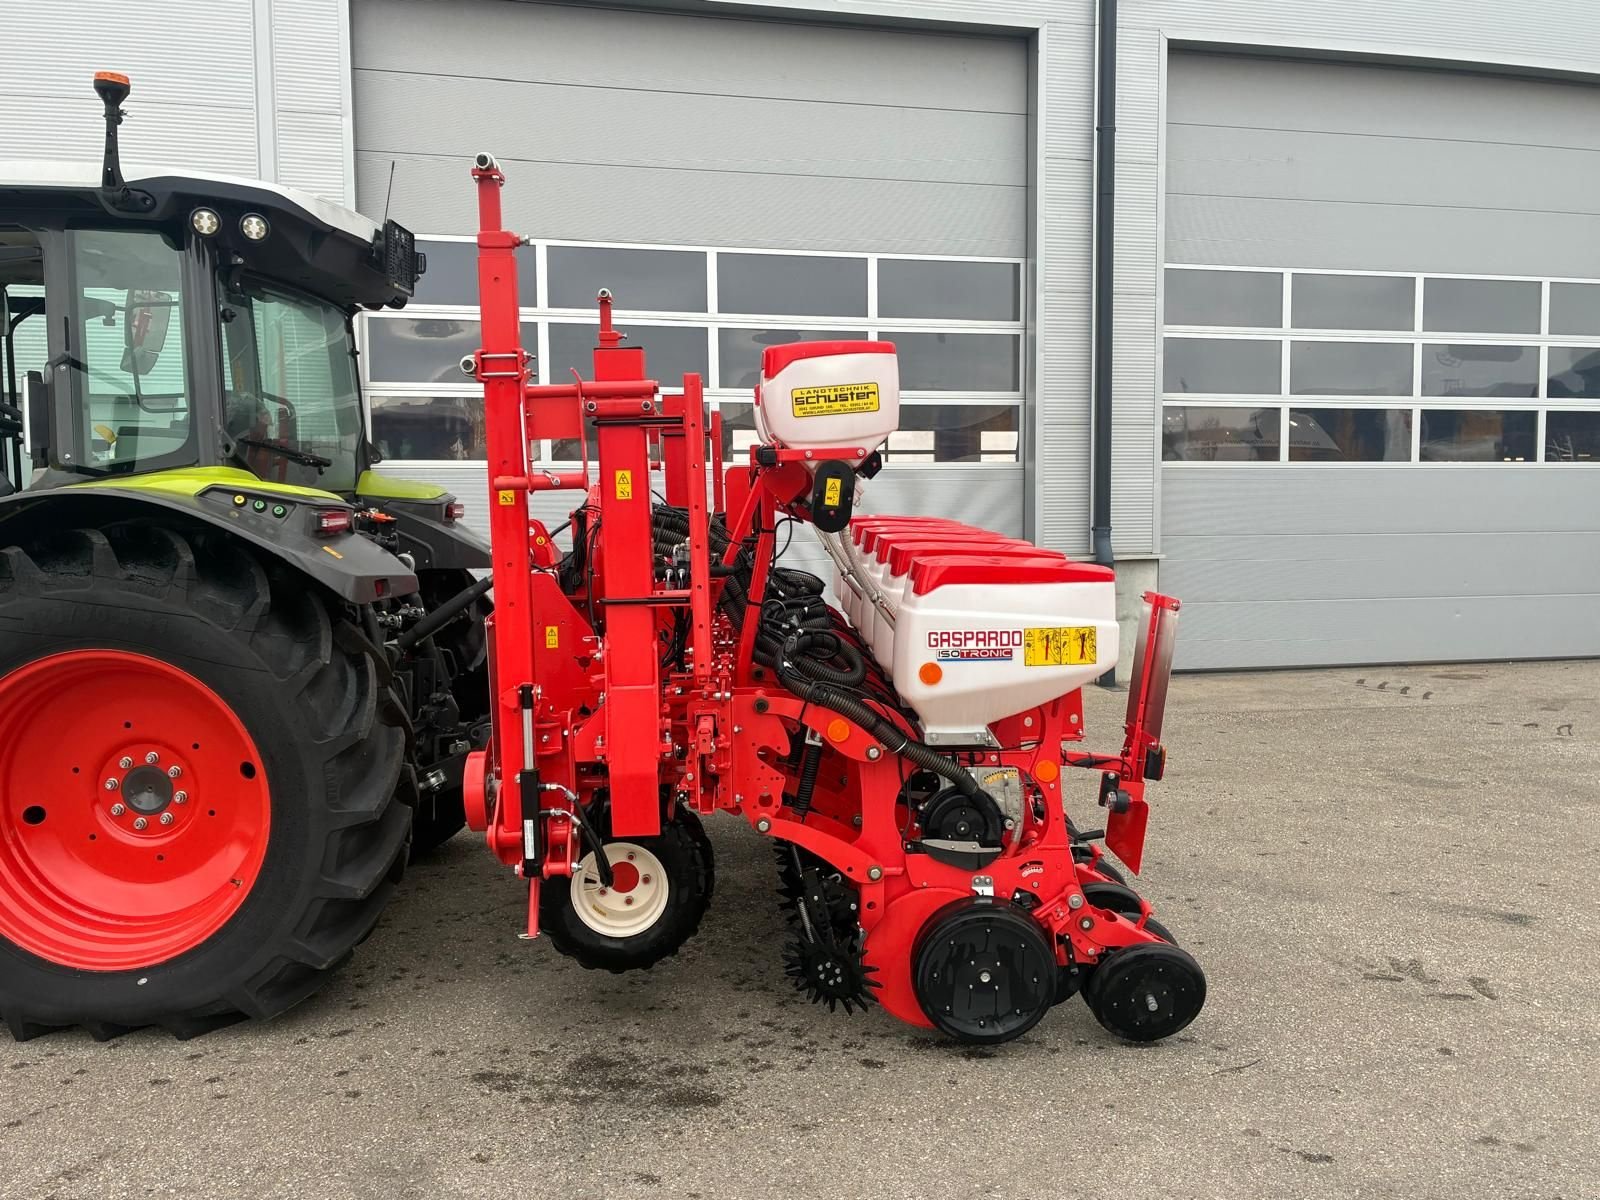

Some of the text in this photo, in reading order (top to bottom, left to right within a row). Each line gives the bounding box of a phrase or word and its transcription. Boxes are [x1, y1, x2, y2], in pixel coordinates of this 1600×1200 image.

[800, 386, 869, 395] LANDTECHNIK
[928, 630, 1022, 648] GASPARDO
[938, 649, 1012, 658] ISOTRONIC
